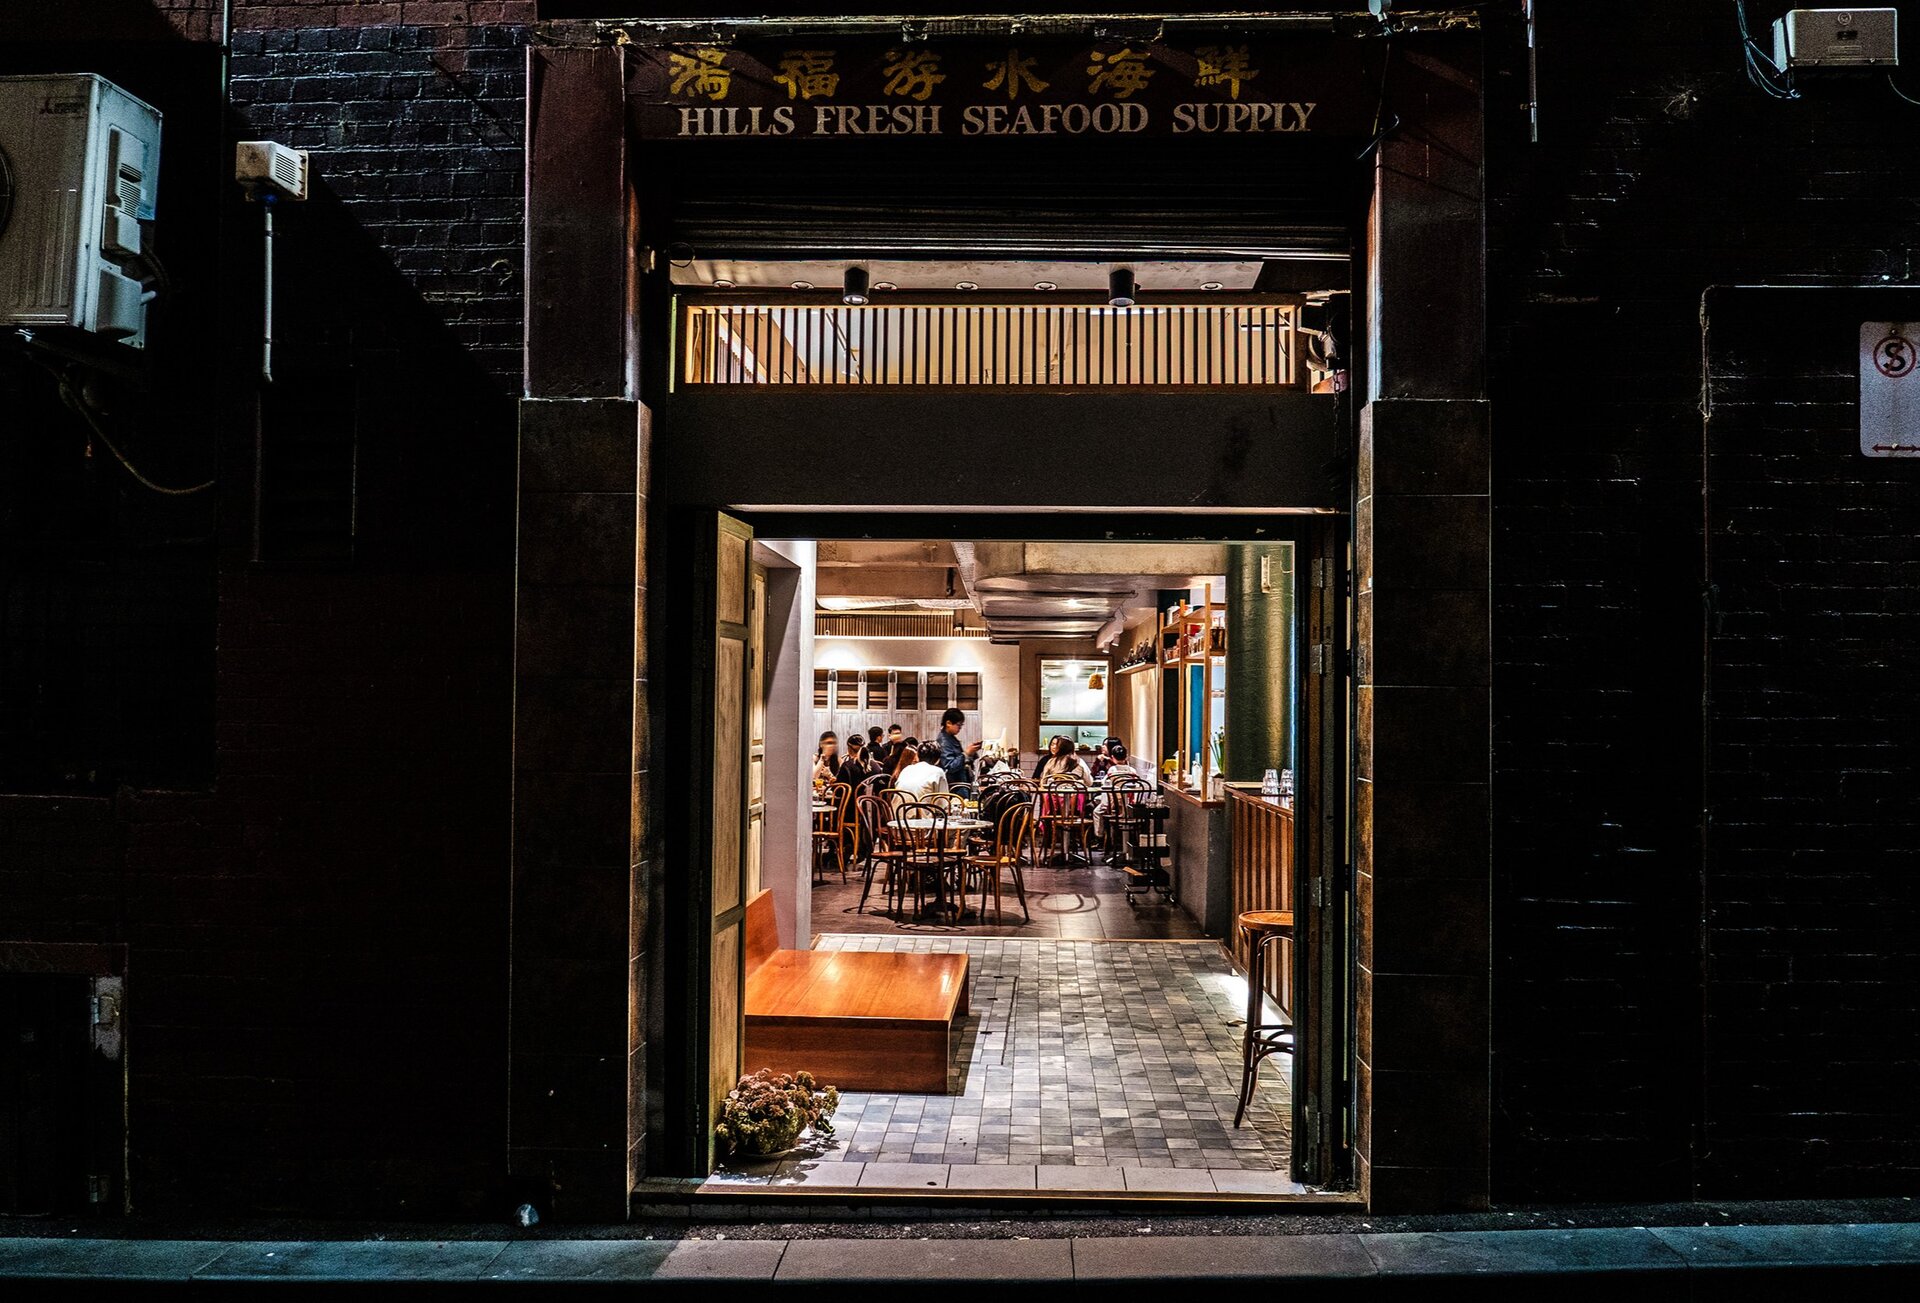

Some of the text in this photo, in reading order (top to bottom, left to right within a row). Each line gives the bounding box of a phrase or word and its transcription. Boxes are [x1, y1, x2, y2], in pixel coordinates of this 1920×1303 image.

[677, 101, 1317, 137] HILLS FRESH SEAFOOD SUPPLY
